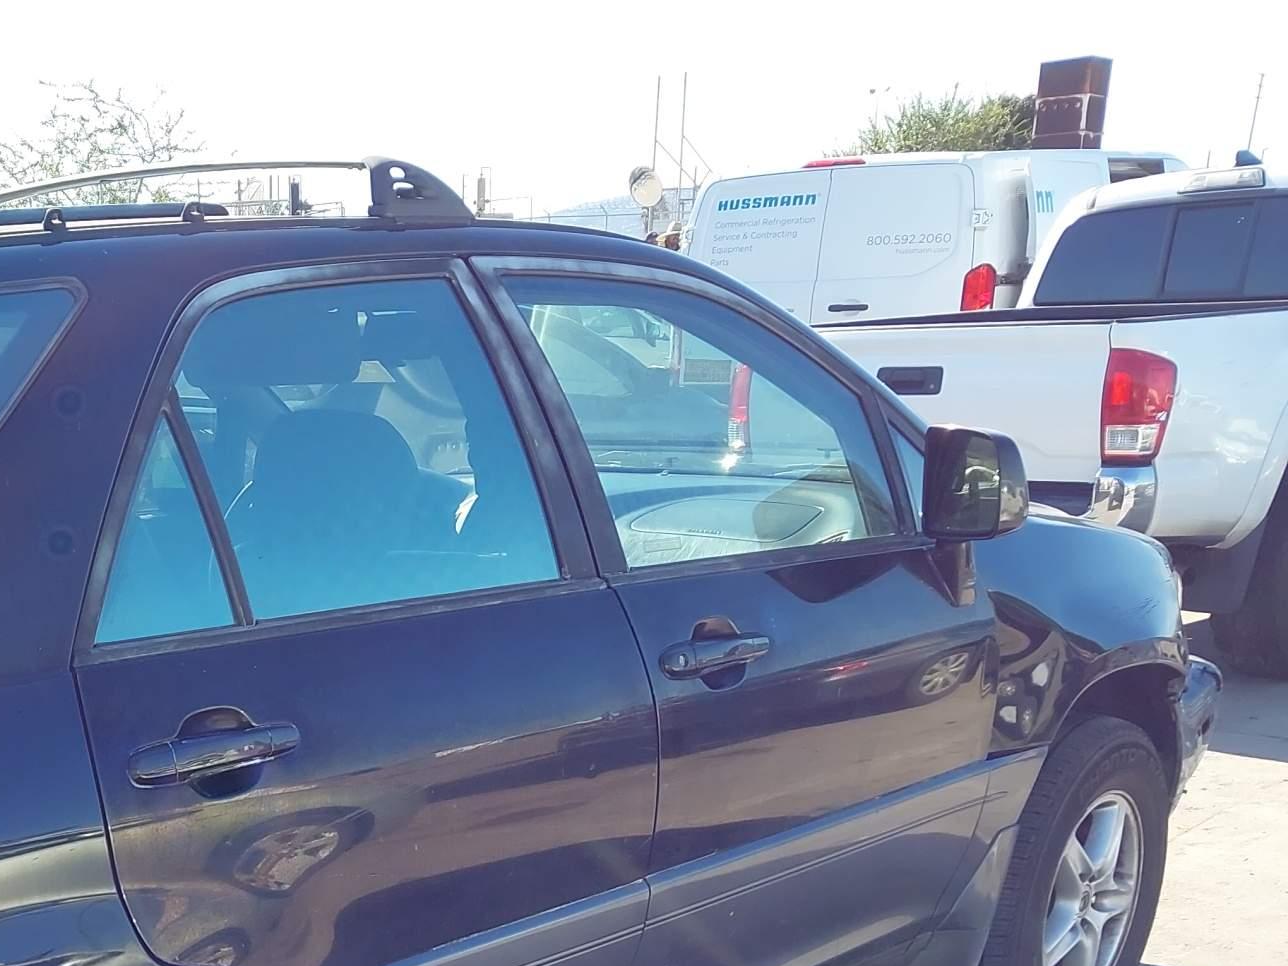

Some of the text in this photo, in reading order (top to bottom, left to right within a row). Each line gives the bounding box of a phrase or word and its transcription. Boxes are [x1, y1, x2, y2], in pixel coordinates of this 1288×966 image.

[714, 216, 816, 229] Commercial Refrigeration
[713, 232, 740, 241] Service
[751, 229, 798, 240] Contracting
[866, 232, 952, 246] 800.592.2060
[712, 245, 753, 255] Equipment
